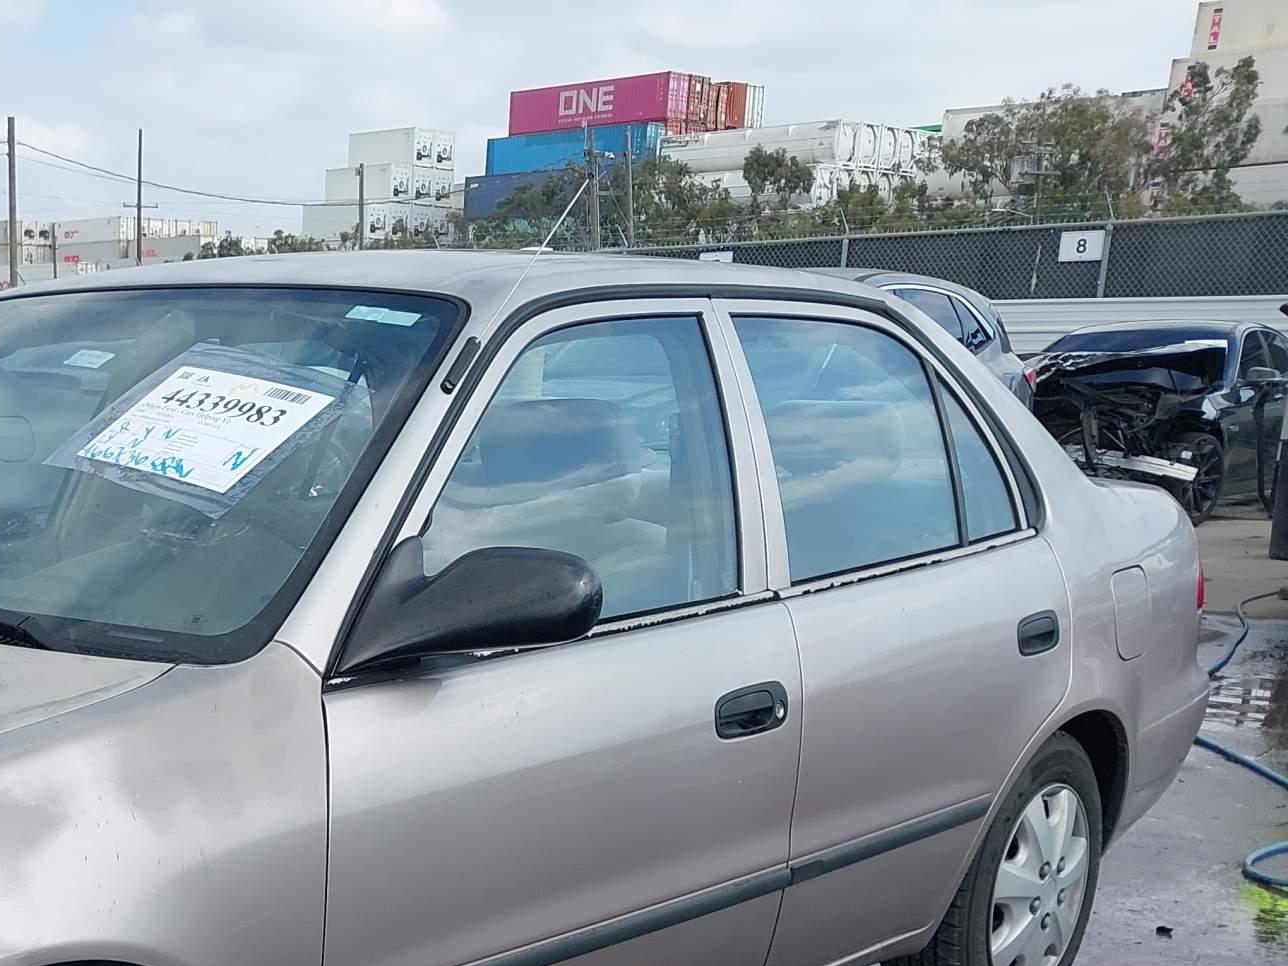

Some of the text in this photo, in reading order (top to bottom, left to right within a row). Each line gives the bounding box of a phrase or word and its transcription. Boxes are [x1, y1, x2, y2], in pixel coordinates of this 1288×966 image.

[559, 85, 615, 116] ONE
[1076, 238, 1087, 254] 8
[161, 388, 287, 427] 44339983
